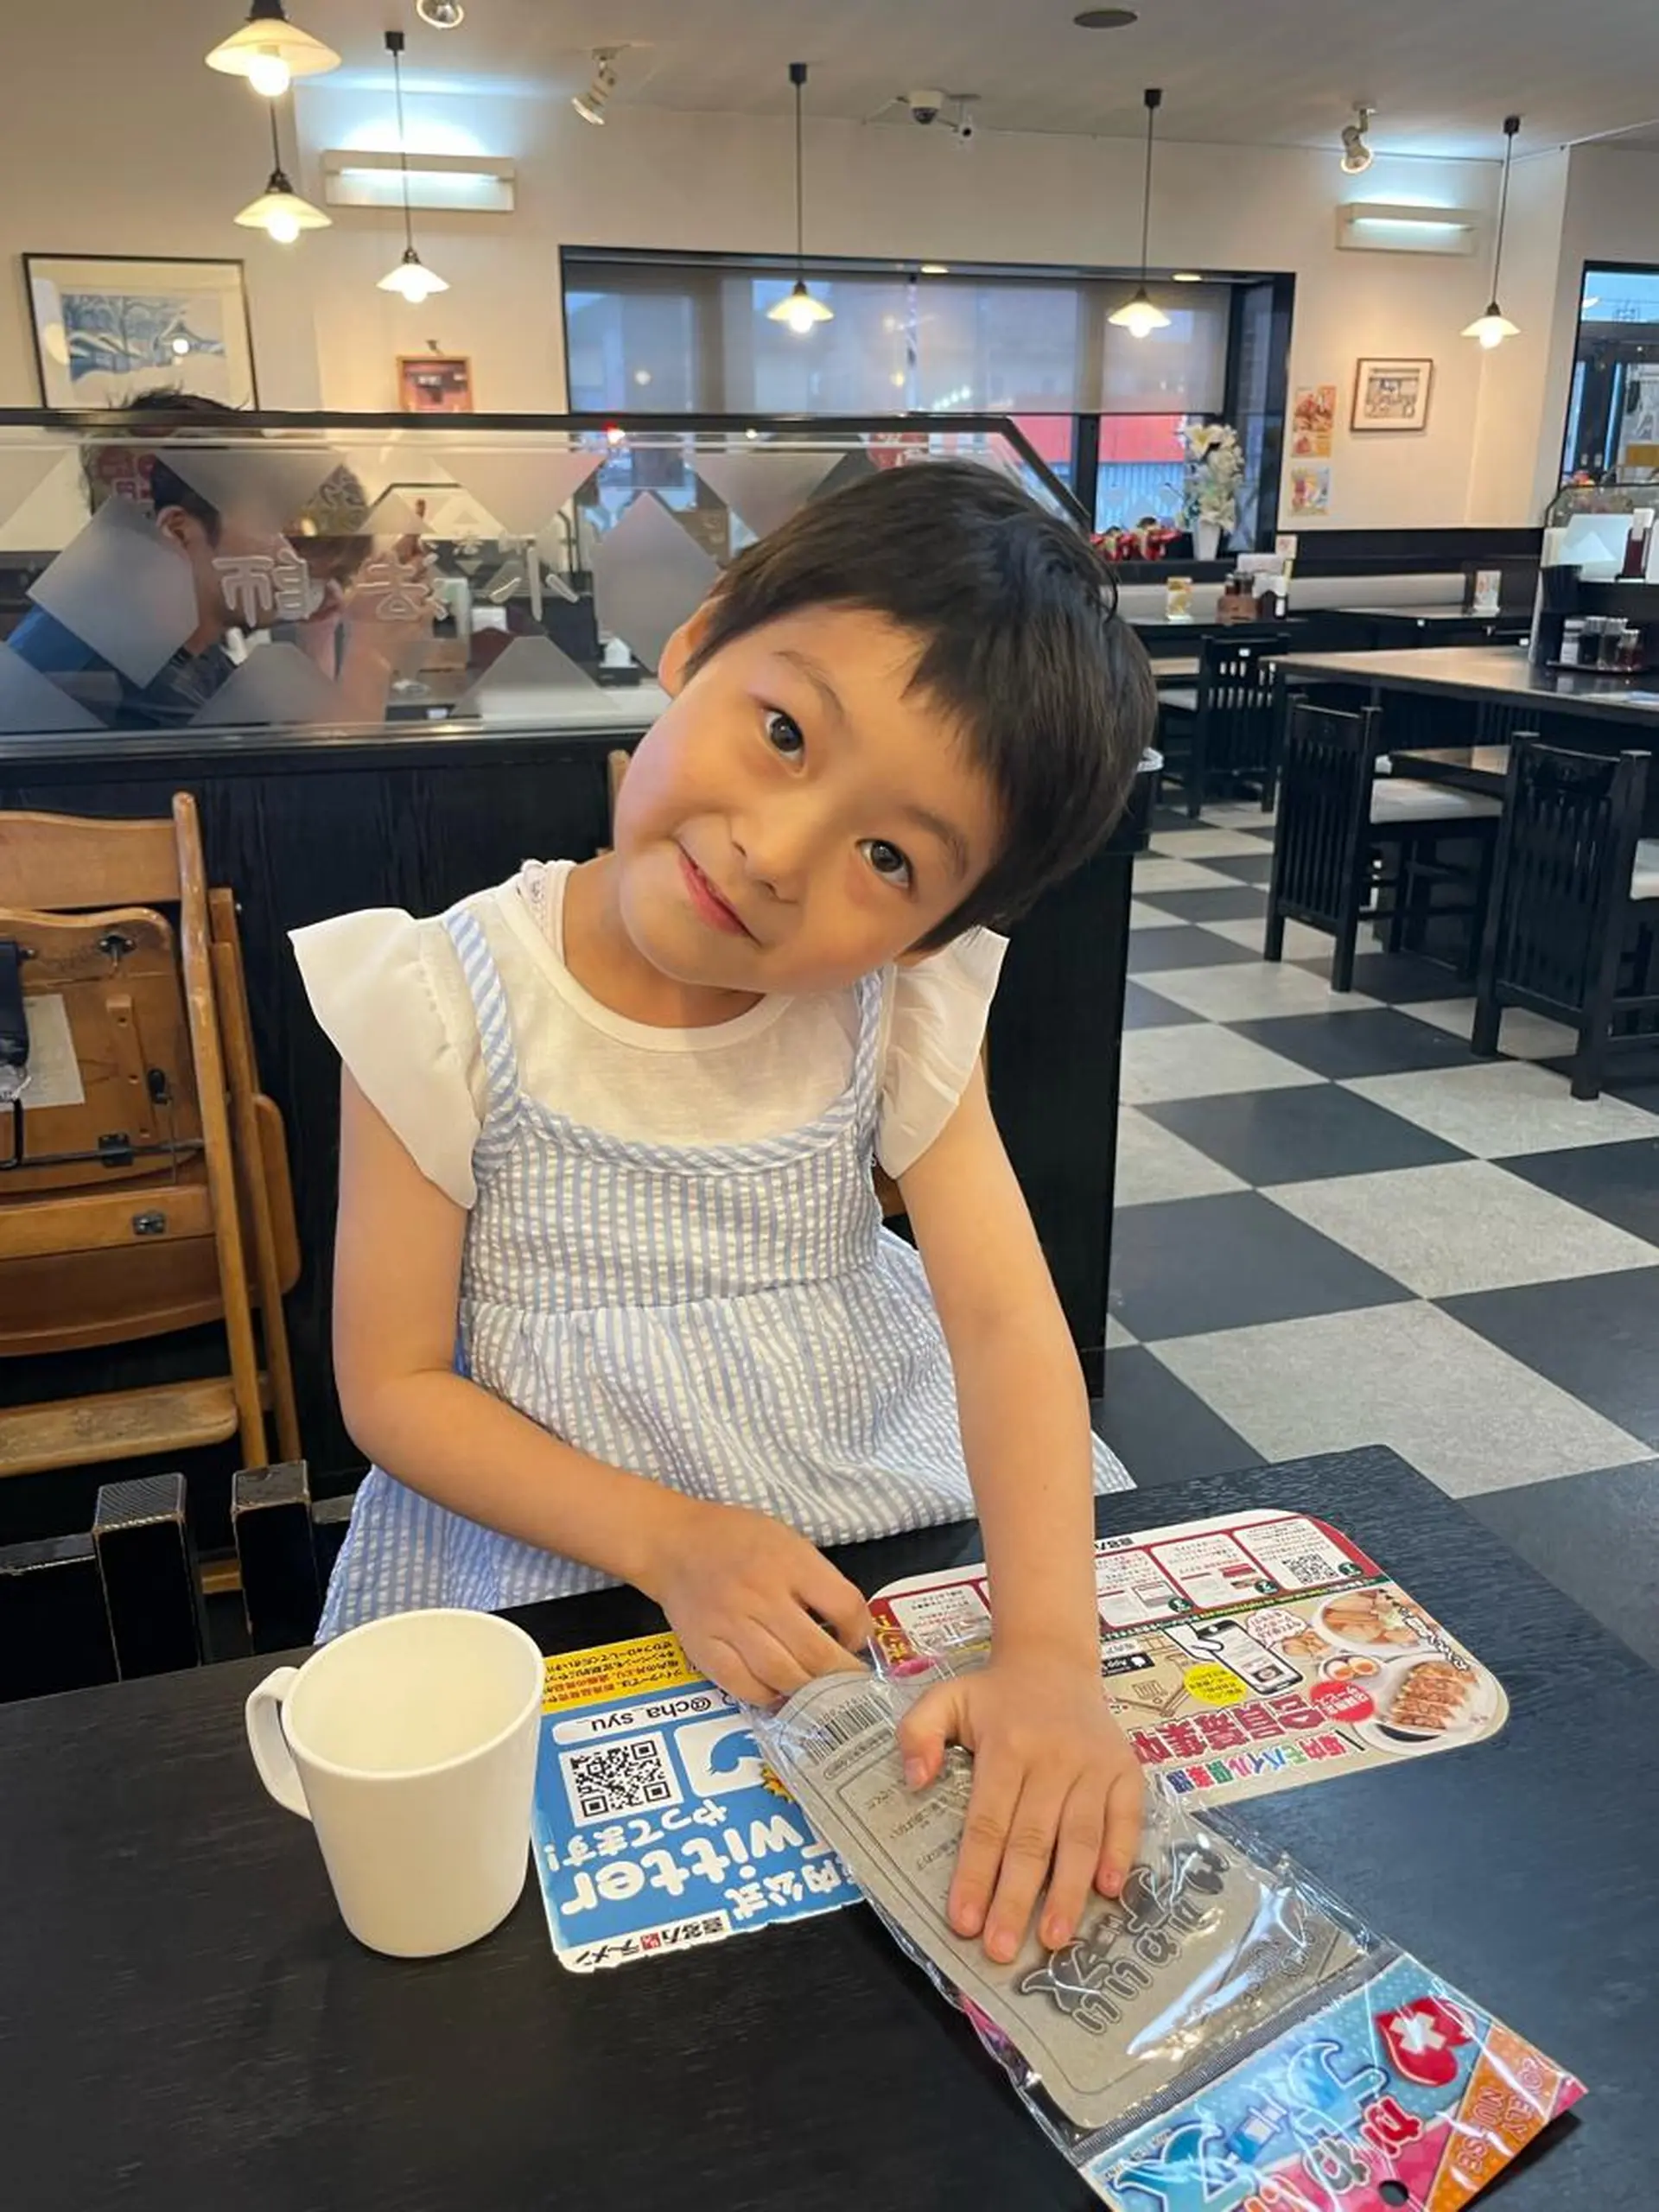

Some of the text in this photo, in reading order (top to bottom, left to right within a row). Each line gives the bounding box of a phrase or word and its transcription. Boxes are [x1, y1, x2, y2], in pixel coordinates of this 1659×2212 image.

[1129, 1692, 1328, 1765] 会員募集中
[724, 1858, 855, 1920] 内公式
